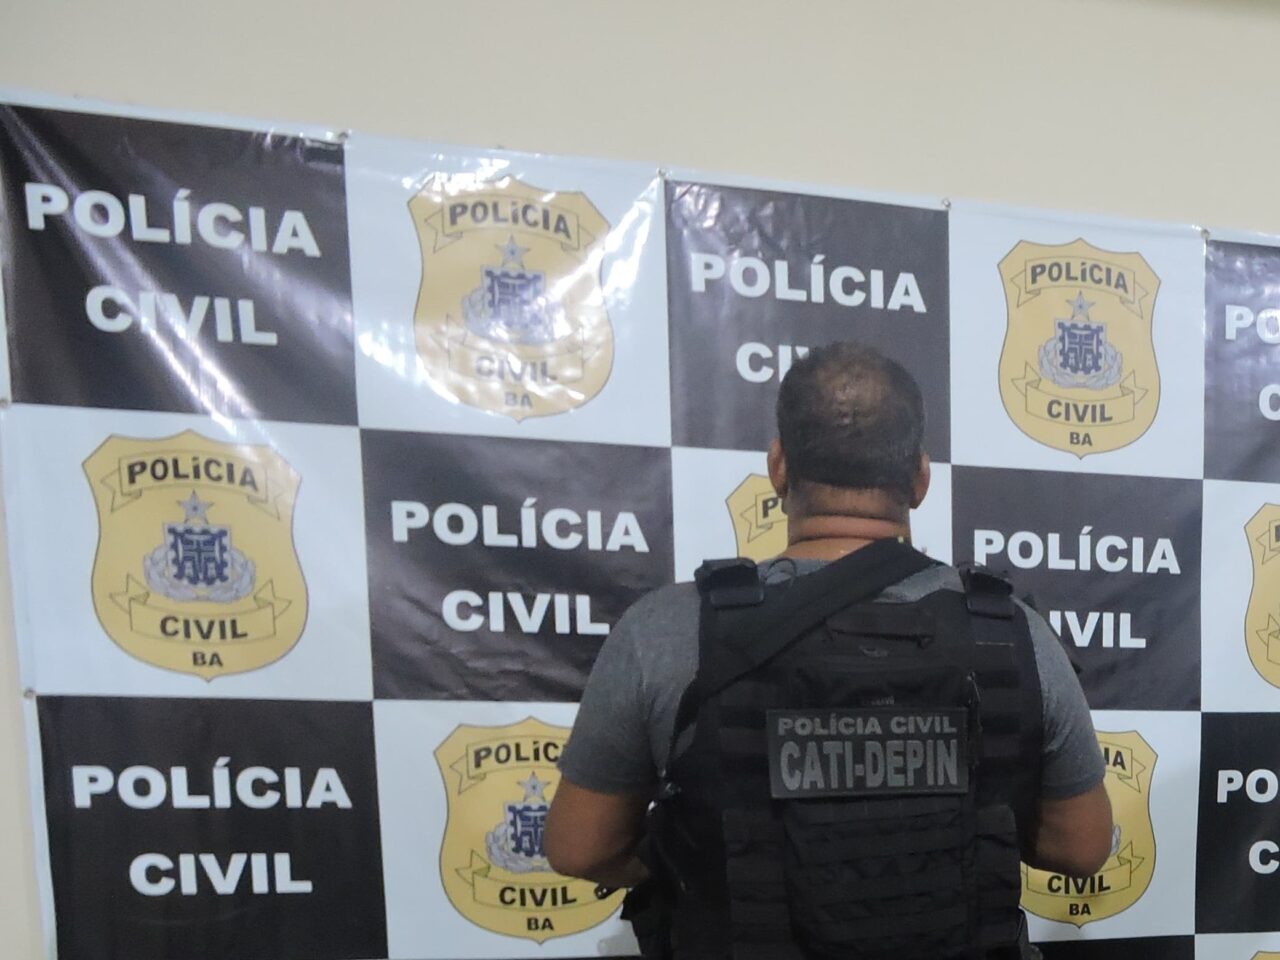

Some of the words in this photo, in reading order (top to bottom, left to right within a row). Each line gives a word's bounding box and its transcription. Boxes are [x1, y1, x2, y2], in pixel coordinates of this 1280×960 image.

[26, 183, 321, 257] POLÍCIA
[690, 252, 926, 313] POLÍCIA
[86, 285, 277, 346] CIVIL
[476, 356, 557, 381] CIVIL
[505, 391, 533, 408] BA
[1047, 400, 1112, 423] CIVIL
[1070, 432, 1092, 446] BA
[392, 497, 649, 552] POLÍCIA
[974, 526, 1180, 574] POLÍCIA
[442, 590, 609, 634] CIVIL
[160, 616, 248, 640] CIVIL
[193, 652, 223, 667] BA
[778, 714, 882, 735] POLÍCIA
[891, 716, 956, 733] CIVIL
[780, 740, 957, 791] CATI-DEPIN
[72, 757, 352, 809] POLÍCIA
[130, 853, 312, 895] CIVIL
[1047, 874, 1111, 895] CIVIL
[499, 886, 576, 907] CIVIL
[1069, 903, 1091, 916] BA
[527, 918, 554, 930] BA
